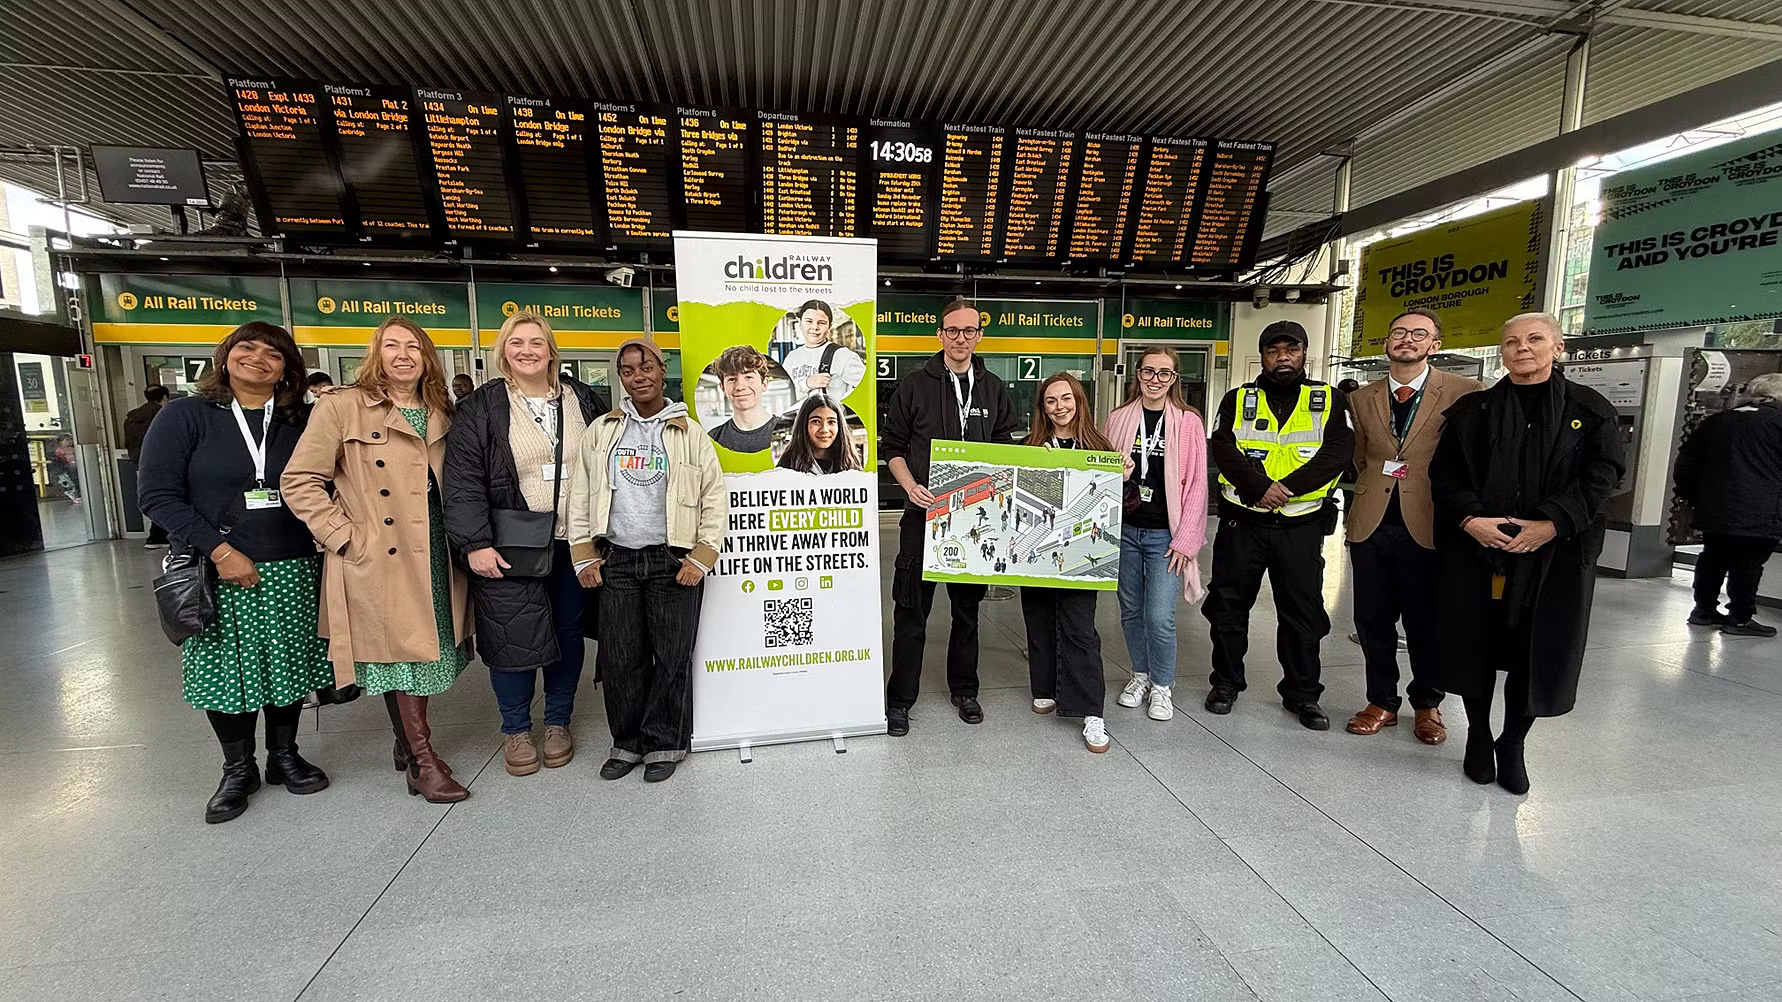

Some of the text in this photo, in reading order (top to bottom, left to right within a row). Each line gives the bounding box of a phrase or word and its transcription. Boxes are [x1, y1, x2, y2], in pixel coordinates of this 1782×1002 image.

[228, 78, 276, 89] Platform 1
[236, 89, 315, 103] 1428 Expt 1433
[324, 85, 371, 97] Platform 2
[417, 89, 463, 101] Platform 3
[331, 95, 408, 110] 1431 Plat 2
[508, 96, 551, 107] Platform 4
[594, 102, 635, 113] Platform 5
[238, 102, 307, 115] London Victoria
[424, 101, 498, 116] 1434 On time
[513, 107, 584, 121] 1438 On time
[677, 107, 717, 117] Platform 6
[242, 114, 264, 123] Calling
[334, 108, 408, 123] via London Bridge
[425, 114, 480, 126] Littlehampton
[598, 112, 667, 126] 1452 On time
[758, 110, 799, 121] Departures
[513, 119, 569, 133] London Bridge
[681, 117, 747, 130] 1436 On time
[870, 118, 911, 128] Information
[944, 123, 1005, 134] Next Fastest Train
[338, 128, 365, 137] Cambridge
[598, 124, 666, 137] London Bridge via
[680, 128, 738, 141] Three Bridges via
[1015, 127, 1075, 138] Next Fastest Train
[1085, 132, 1142, 143] Next Fastest Train
[1152, 136, 1167, 144] Next
[1167, 137, 1191, 146] Fastest
[1218, 140, 1272, 151] Next Fastest Train
[1721, 161, 1767, 175] THIS IS
[1657, 173, 1697, 186] THIS IS
[1663, 175, 1720, 191] CROYDON
[1607, 186, 1657, 200] CROYDON
[1603, 237, 1657, 258] THIS
[1661, 231, 1686, 248] IS
[1616, 230, 1778, 272] AND YOU'RE
[789, 254, 831, 262] RAILWAY
[724, 255, 833, 281] children
[1378, 253, 1455, 285] THIS IS
[1390, 259, 1508, 298] CROYDON
[725, 284, 737, 292] No
[739, 284, 759, 292] child
[761, 285, 777, 293] lost
[789, 286, 803, 294] the
[144, 296, 257, 311] All Rail Tickets
[1403, 286, 1489, 308] LONDON BOROUGH
[1599, 294, 1641, 305] CROYDON
[341, 300, 446, 314] All Rail Tickets
[524, 304, 621, 318] All Rail Tickets
[877, 311, 937, 324] ail Tickets
[998, 313, 1083, 327] All Rail Tickets
[1137, 316, 1213, 328] All Rail Tickets
[81, 355, 91, 368] 7
[1568, 350, 1612, 361] Tickets
[189, 360, 206, 380] 7
[560, 363, 574, 378] 5
[877, 358, 890, 377] 3
[1023, 358, 1036, 379] 2
[27, 377, 38, 390] 30
[730, 487, 868, 508] BELIEVE IN A WORLD
[729, 509, 859, 531] HERE EVERY CHILD
[737, 534, 788, 553] THRIVE
[791, 532, 828, 550] AWAY
[831, 530, 869, 548] FROM
[943, 546, 959, 557] 200
[720, 558, 750, 576] LIFE
[753, 556, 772, 574] ON
[775, 555, 803, 572] THE
[806, 552, 869, 571] STREETS.
[705, 648, 871, 673] WWW.RAILWAYCHILDREN.ORG.UK
